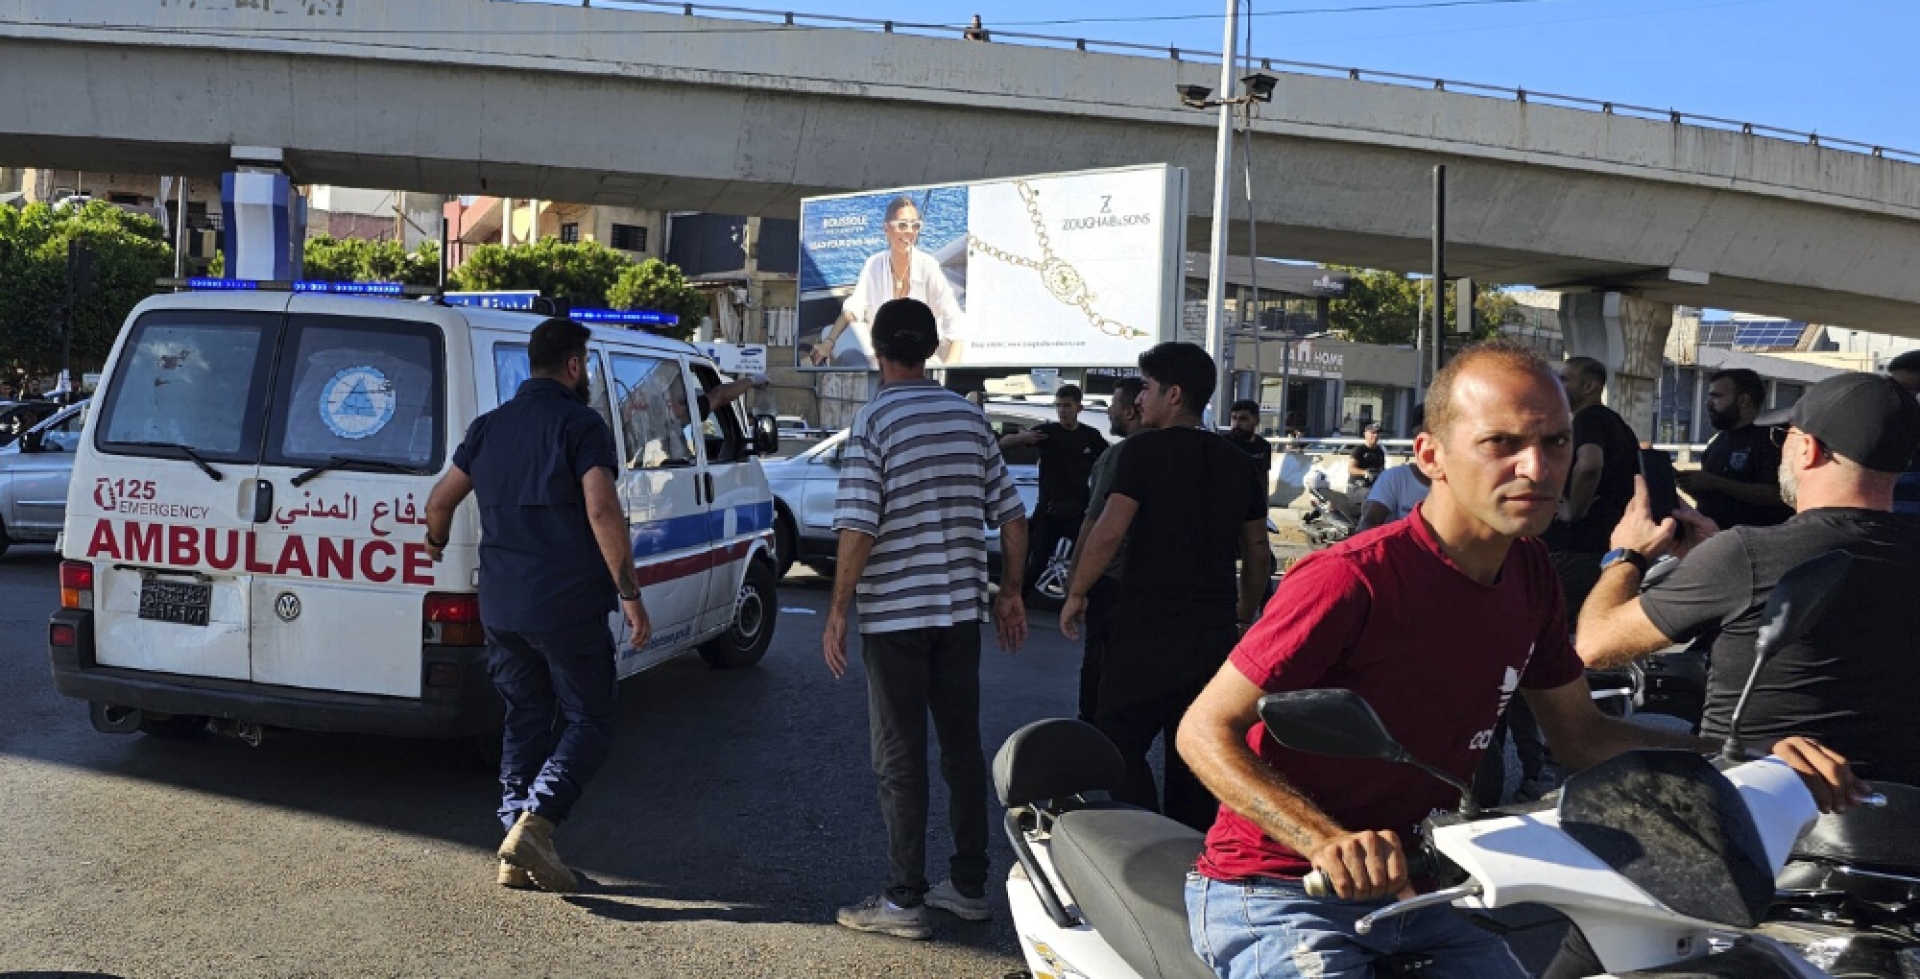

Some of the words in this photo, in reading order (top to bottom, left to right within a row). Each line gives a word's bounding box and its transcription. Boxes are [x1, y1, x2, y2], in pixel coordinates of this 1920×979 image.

[1315, 350, 1343, 366] HOME
[115, 478, 156, 500] 125
[119, 501, 210, 519] EMERGENCY
[275, 490, 357, 530] المدني
[87, 518, 435, 586] AMBULANCE
